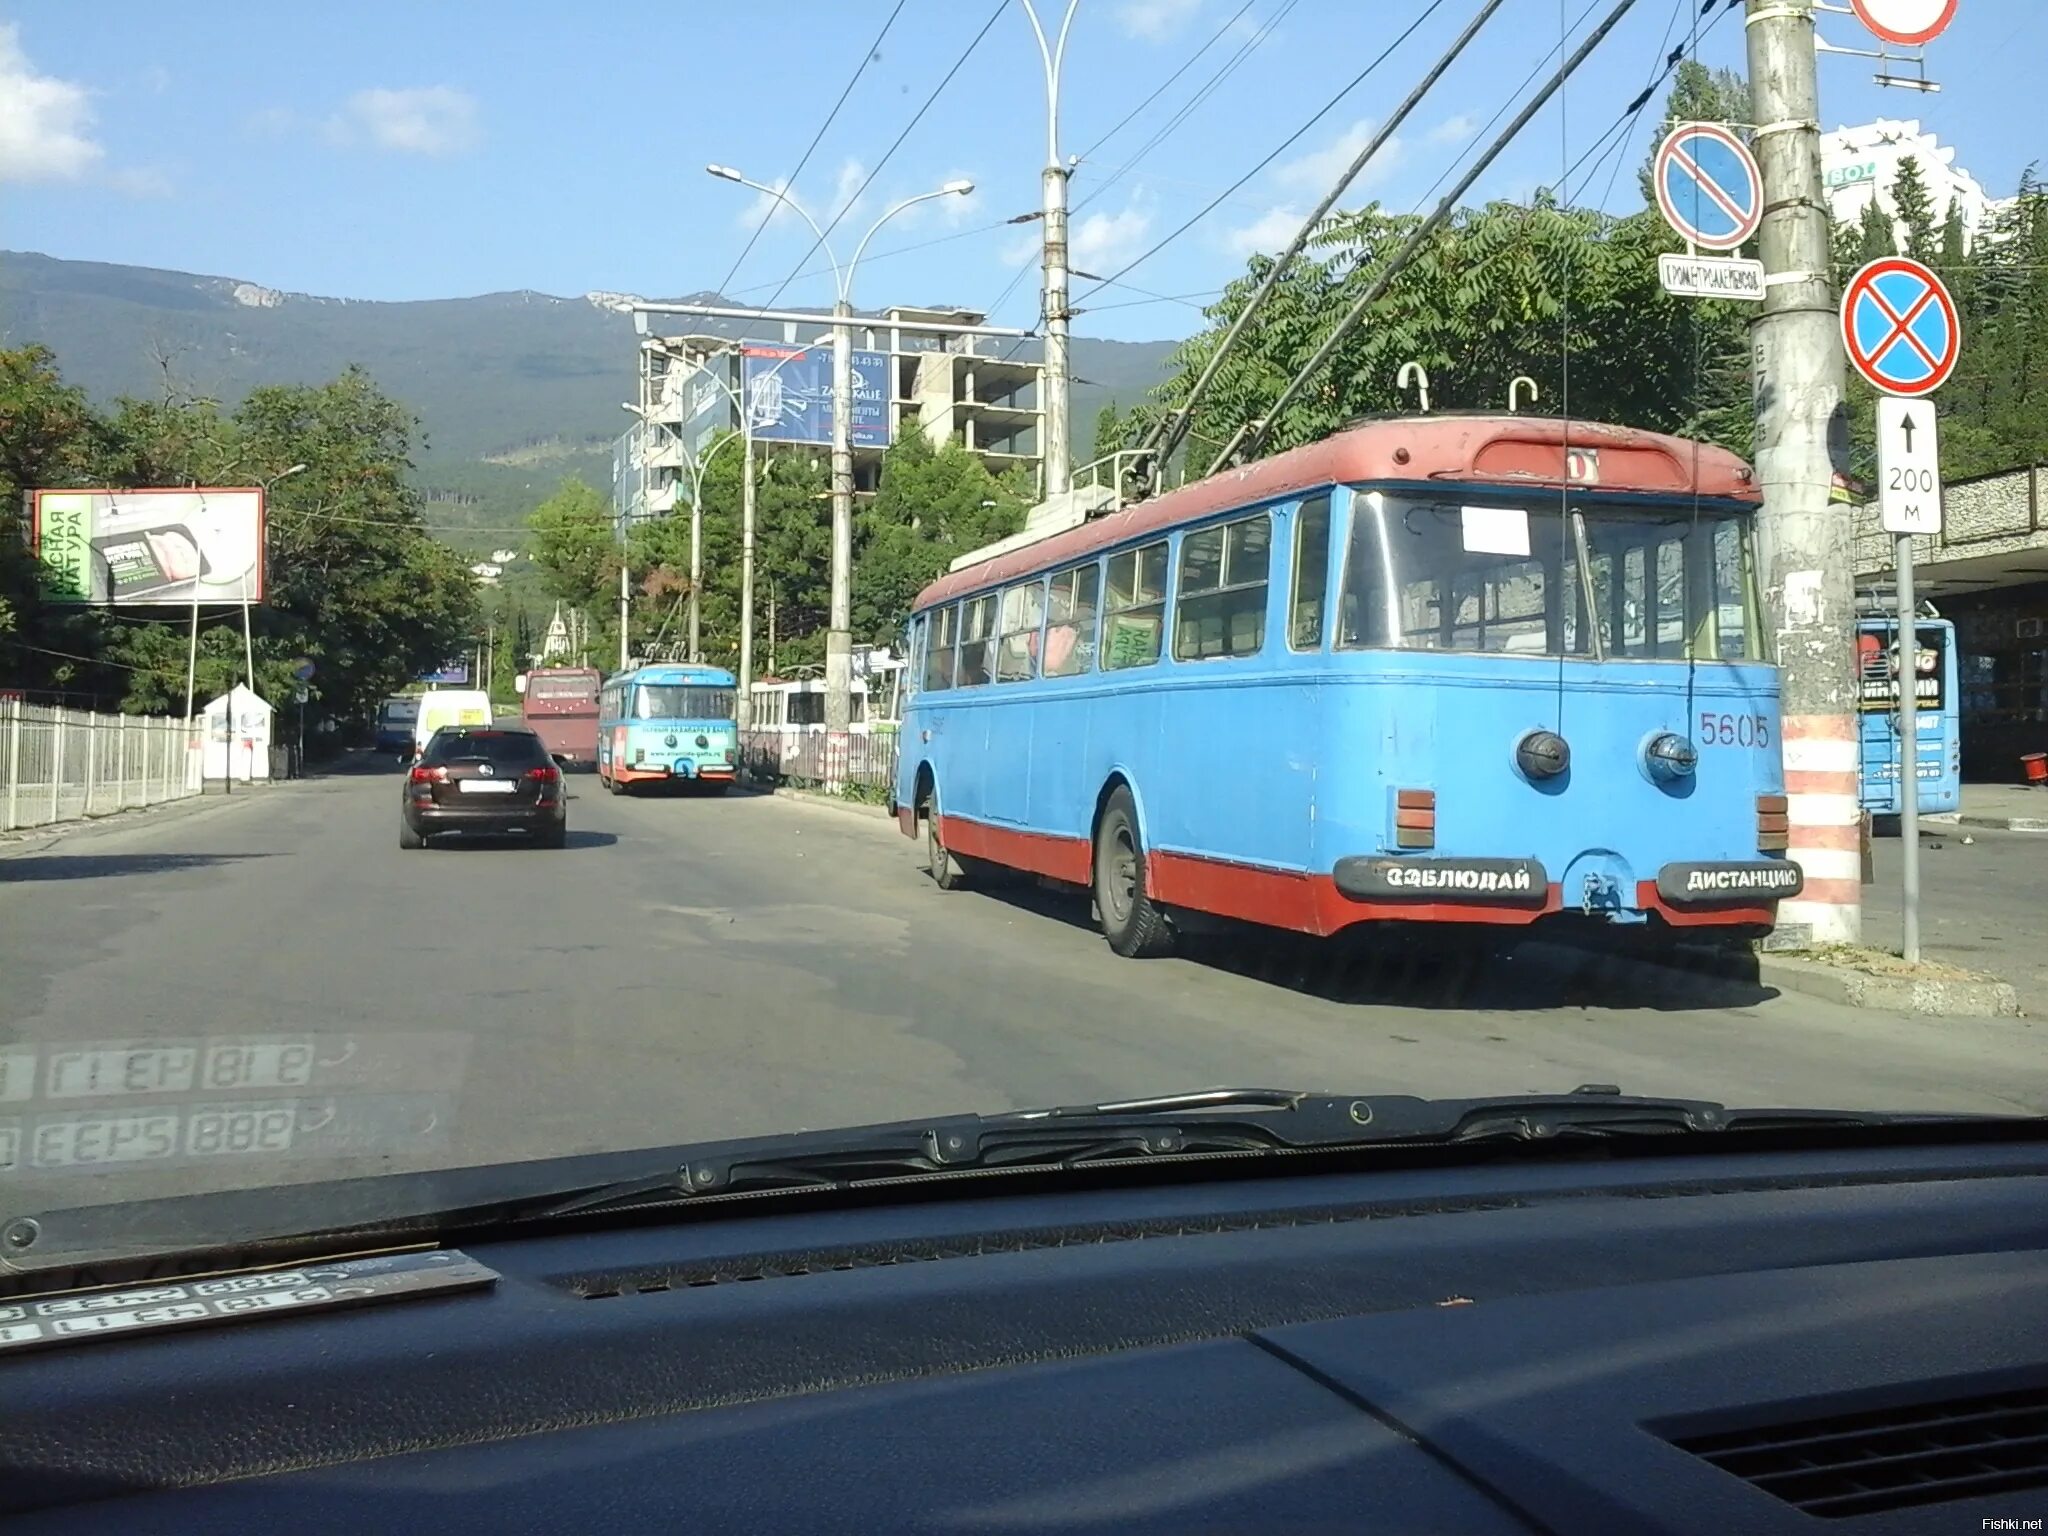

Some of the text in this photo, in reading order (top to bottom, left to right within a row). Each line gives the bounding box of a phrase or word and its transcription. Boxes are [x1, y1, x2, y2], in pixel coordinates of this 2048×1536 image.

[1889, 466, 1933, 493] 200
[1700, 712, 1769, 749] 5605
[1686, 868, 1798, 890] ДИСТАНЦИЮ
